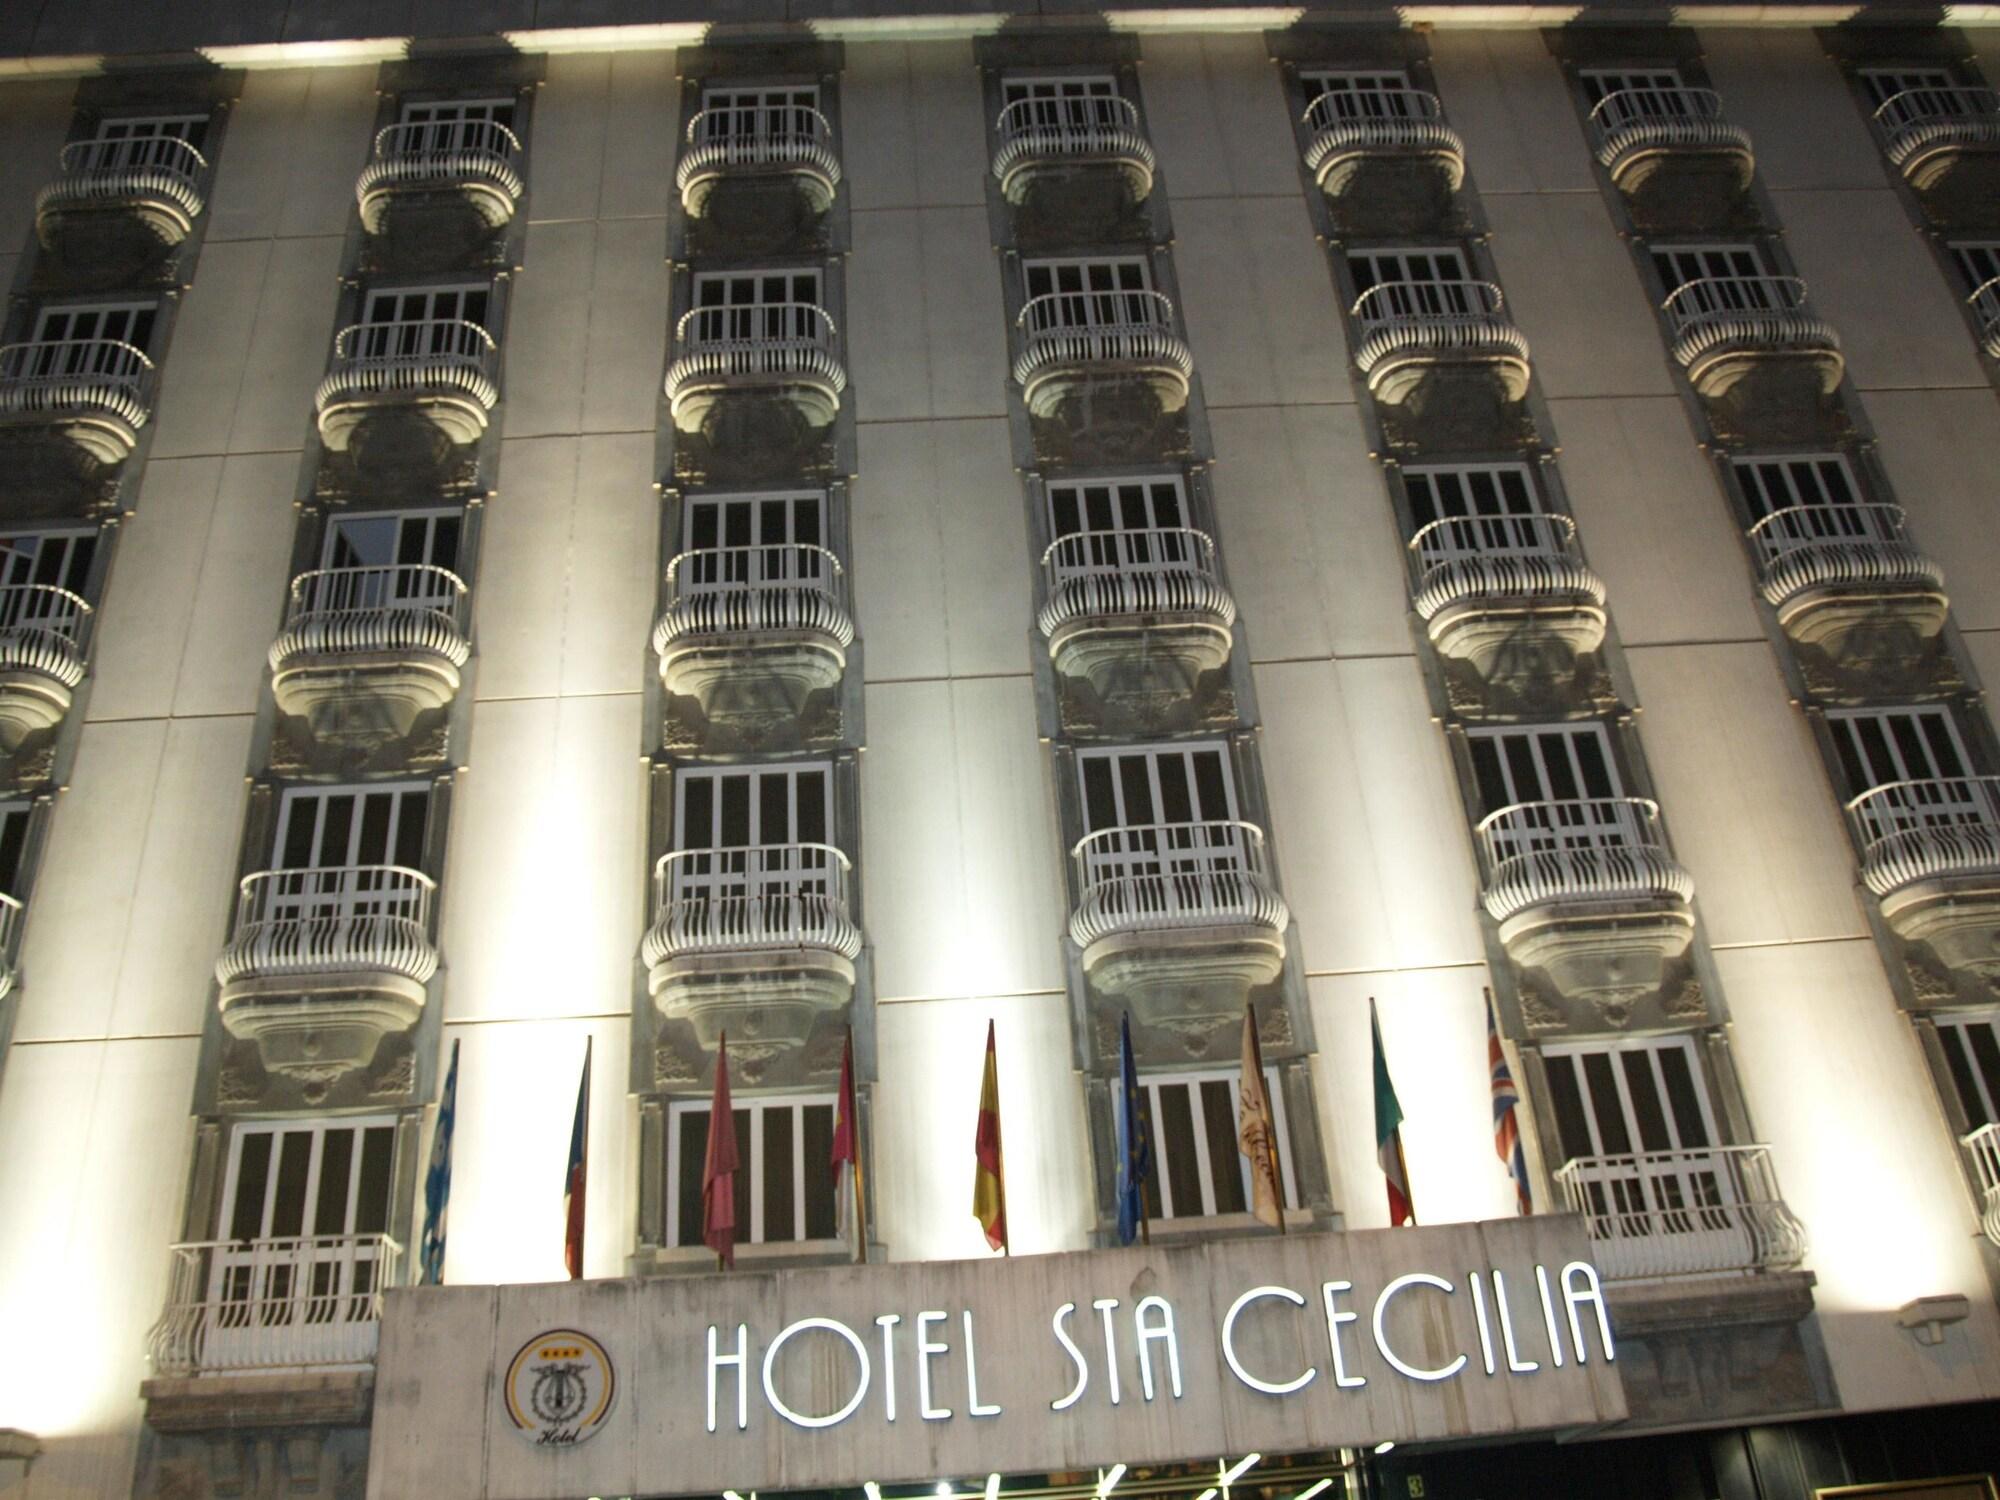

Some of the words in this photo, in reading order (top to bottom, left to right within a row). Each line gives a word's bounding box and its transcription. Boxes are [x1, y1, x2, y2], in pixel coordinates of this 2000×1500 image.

[706, 1309, 1002, 1433] HOTEL
[1050, 1294, 1183, 1410] STA
[1220, 1260, 1616, 1395] CECILIA
[536, 1426, 582, 1446] Hotel
